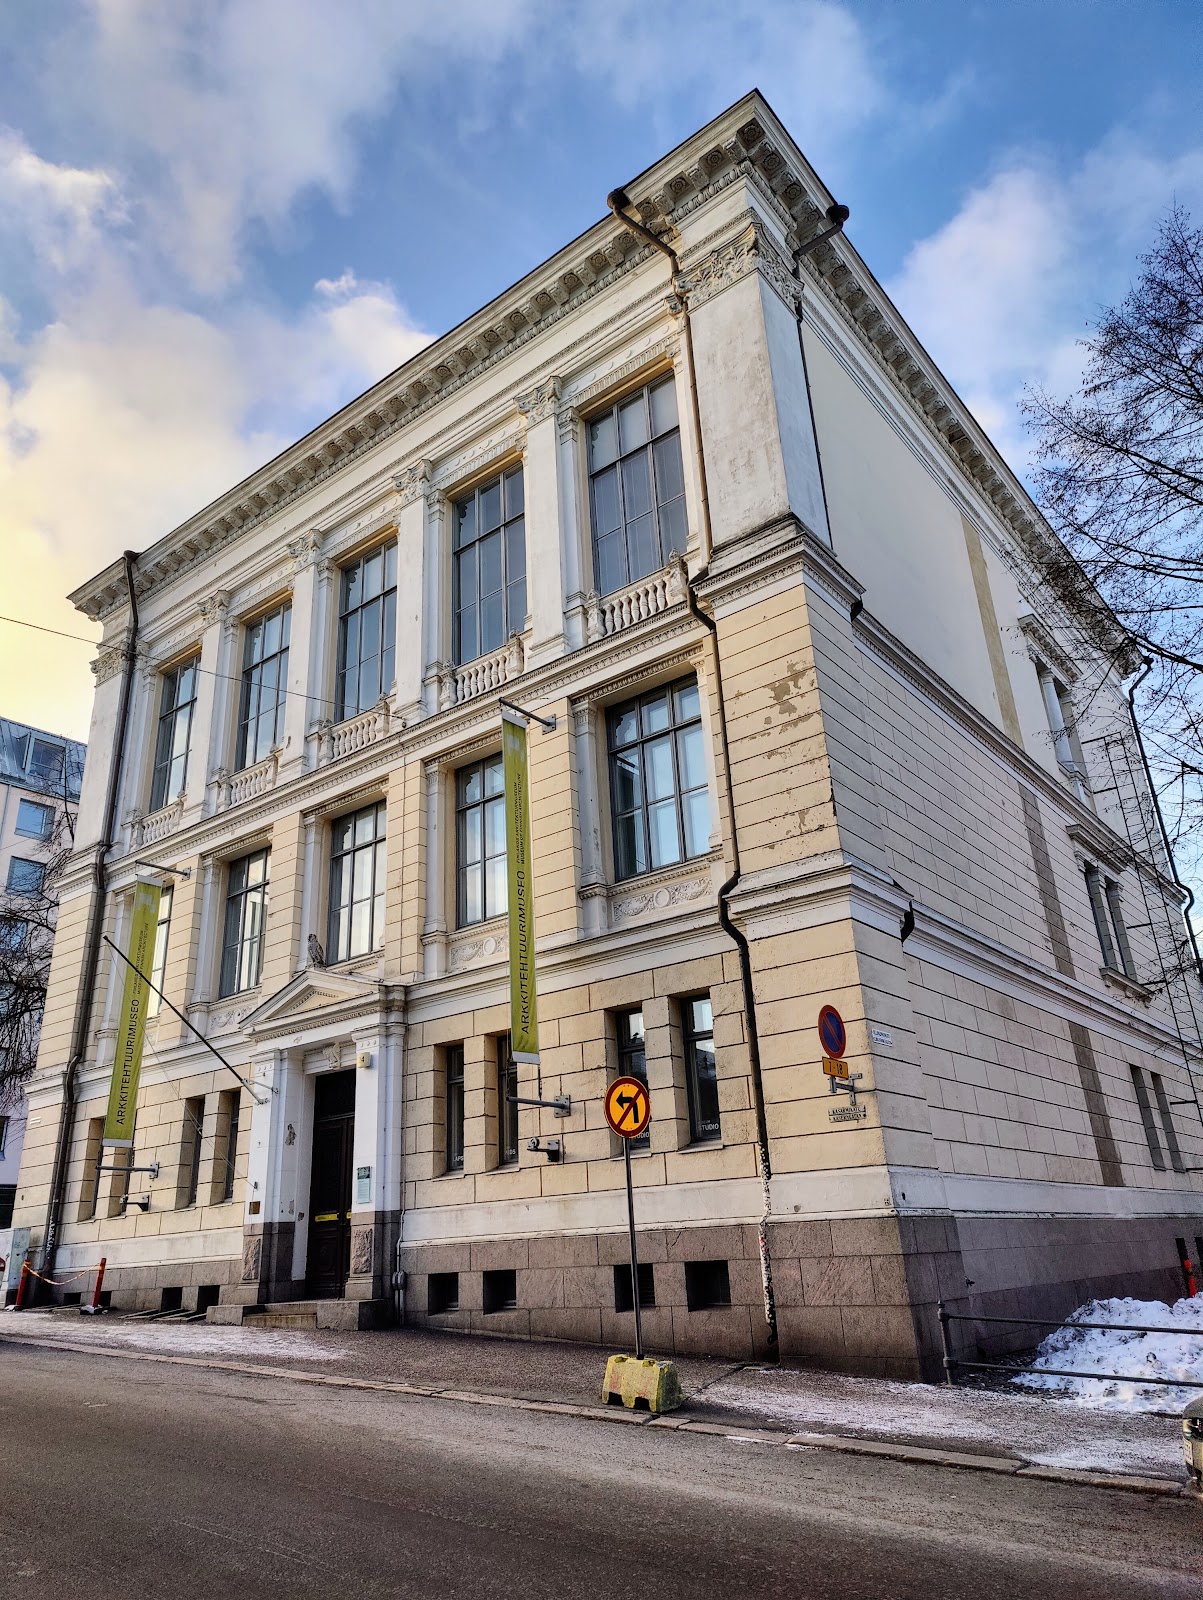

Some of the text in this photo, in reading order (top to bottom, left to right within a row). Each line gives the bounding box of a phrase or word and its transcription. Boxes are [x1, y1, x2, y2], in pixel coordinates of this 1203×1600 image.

[516, 870, 529, 1034] ARKKITEHTUURIMUSEO
[116, 999, 139, 1124] ARKKITEHTUURIMUSEO
[698, 1123, 719, 1131] STUDIO
